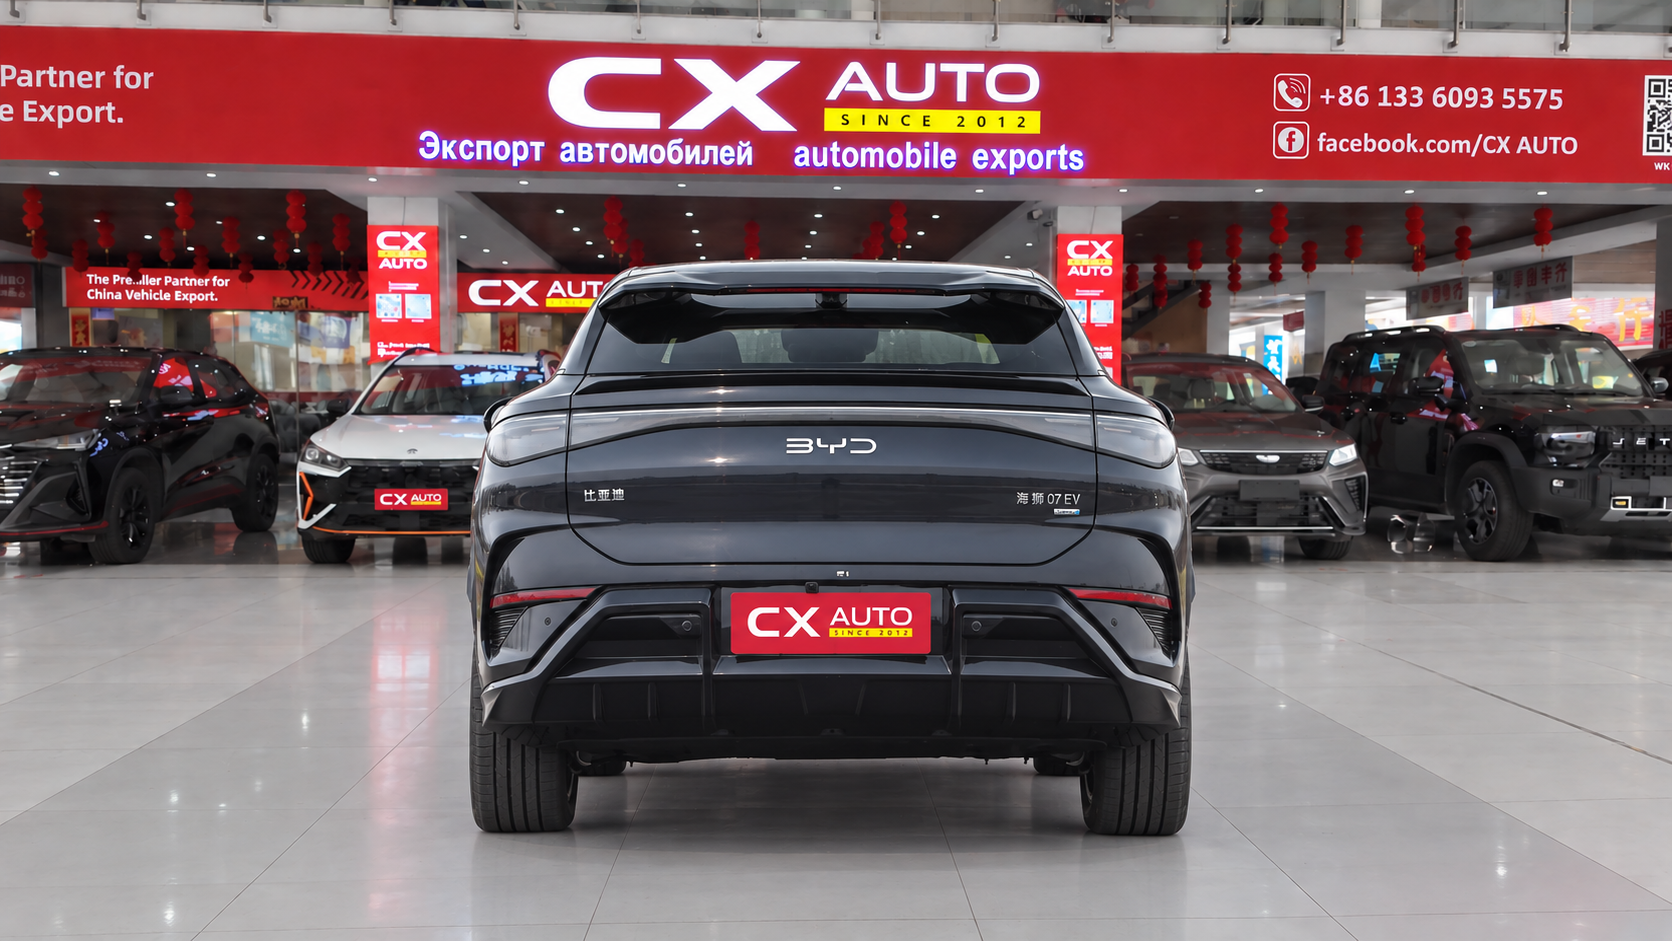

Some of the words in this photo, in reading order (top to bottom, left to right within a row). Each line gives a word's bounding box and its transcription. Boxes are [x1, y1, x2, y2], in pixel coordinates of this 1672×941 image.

[0, 64, 106, 89] Partner
[113, 64, 154, 89] for
[548, 56, 800, 132] CX
[825, 61, 1040, 103] AUTO
[1320, 85, 1369, 107] +86
[1378, 86, 1424, 108] 133
[1432, 86, 1494, 108] 6093
[1502, 88, 1563, 110] 5575
[23, 100, 124, 129] Export.
[841, 113, 931, 127] SINCE
[956, 115, 1026, 128] 2012
[418, 130, 545, 167] Экспорт
[559, 138, 754, 166] автомобилей
[1317, 132, 1511, 158] facebook.com/CX
[1516, 136, 1578, 155] AUTO
[793, 140, 958, 170] automobile
[971, 143, 1085, 176] exports
[376, 230, 427, 251] CX
[1066, 239, 1114, 260] CX
[378, 257, 428, 270] AUTO
[1067, 265, 1113, 277] AUTO
[86, 273, 110, 285] The
[164, 275, 211, 287] Partner
[211, 275, 231, 287] for
[86, 288, 122, 300] China
[124, 288, 171, 301] Vehicle
[174, 290, 218, 304] Export.
[468, 279, 539, 307] CX
[546, 280, 608, 298] AUT
[785, 437, 877, 455] BYD
[379, 493, 408, 506] CX
[410, 493, 442, 502] AUTO
[584, 488, 625, 502] 比亚迪
[1047, 493, 1062, 505] 07
[1064, 493, 1081, 505] EV
[747, 606, 821, 638] CX
[829, 606, 913, 626] AUTO
[834, 629, 870, 637] SINCE
[879, 629, 909, 637] 2012
